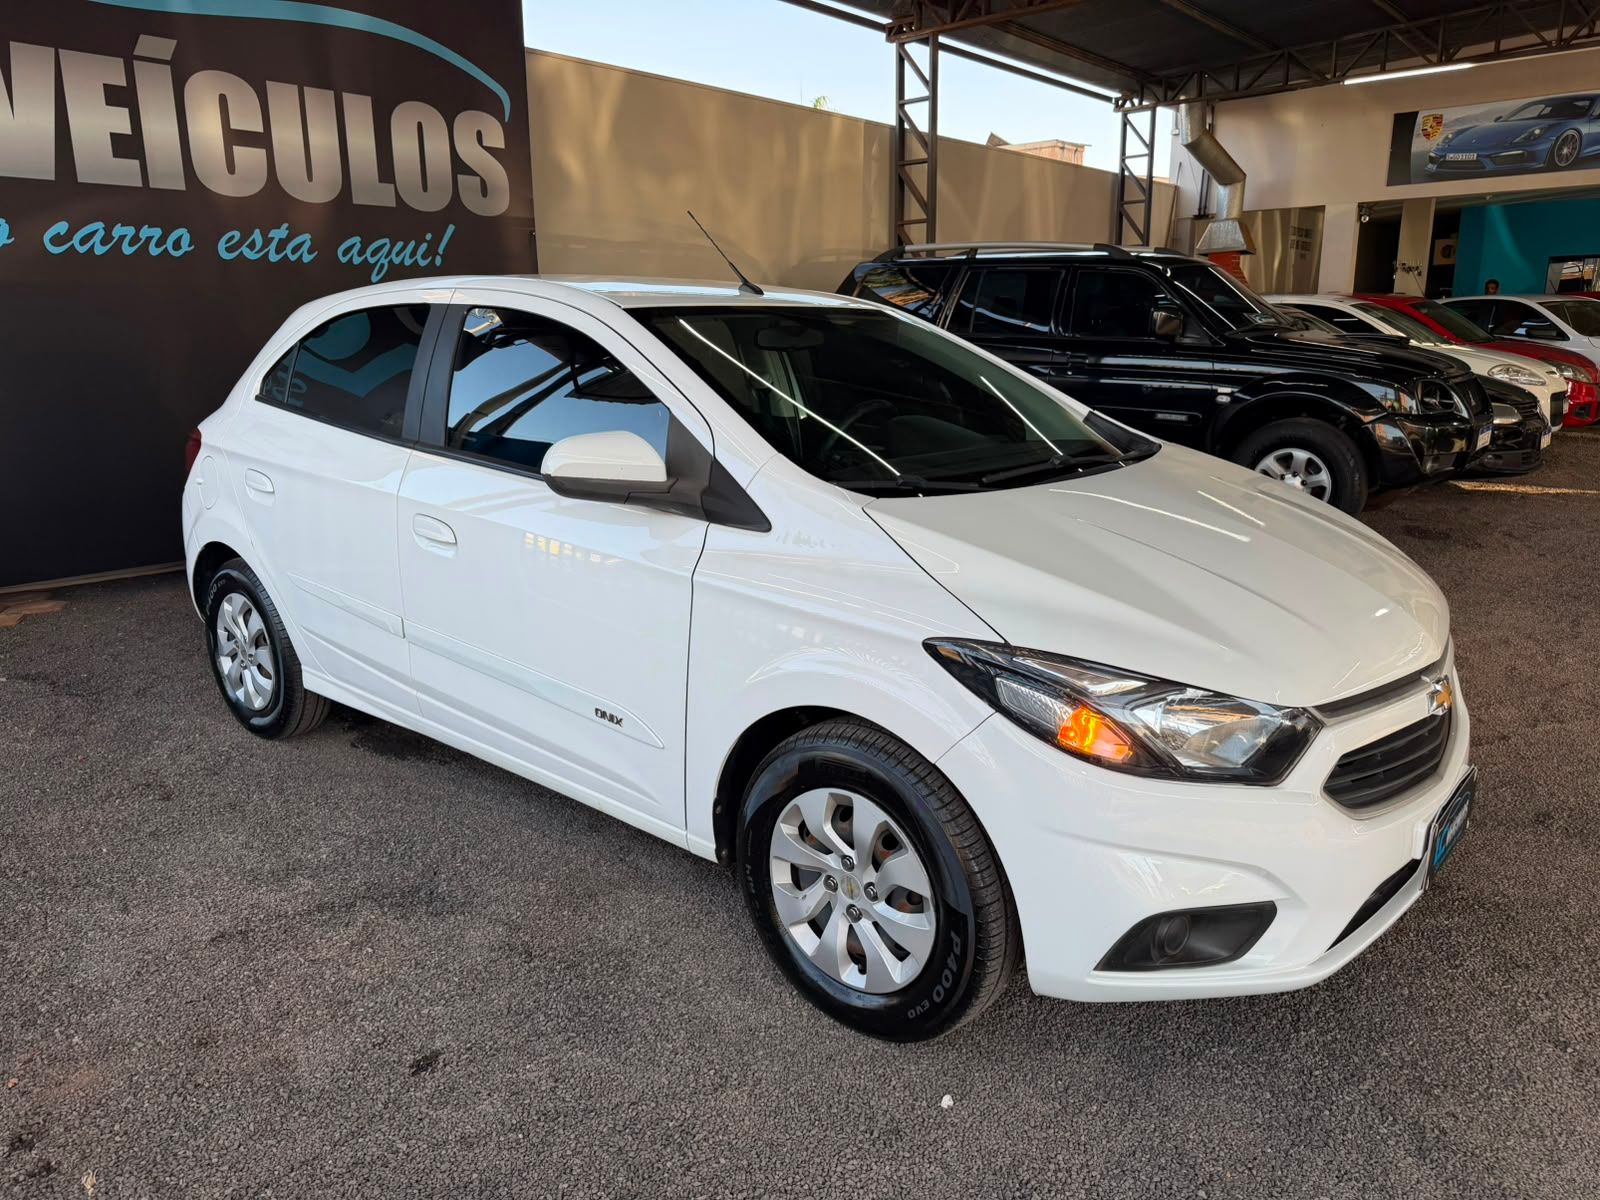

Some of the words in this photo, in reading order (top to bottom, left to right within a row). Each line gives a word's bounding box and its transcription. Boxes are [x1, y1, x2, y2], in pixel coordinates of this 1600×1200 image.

[43, 220, 193, 257] carro
[217, 223, 317, 263] esta
[337, 224, 456, 283] aqui!
[595, 708, 623, 727] ONIX
[932, 930, 961, 1003] P400
